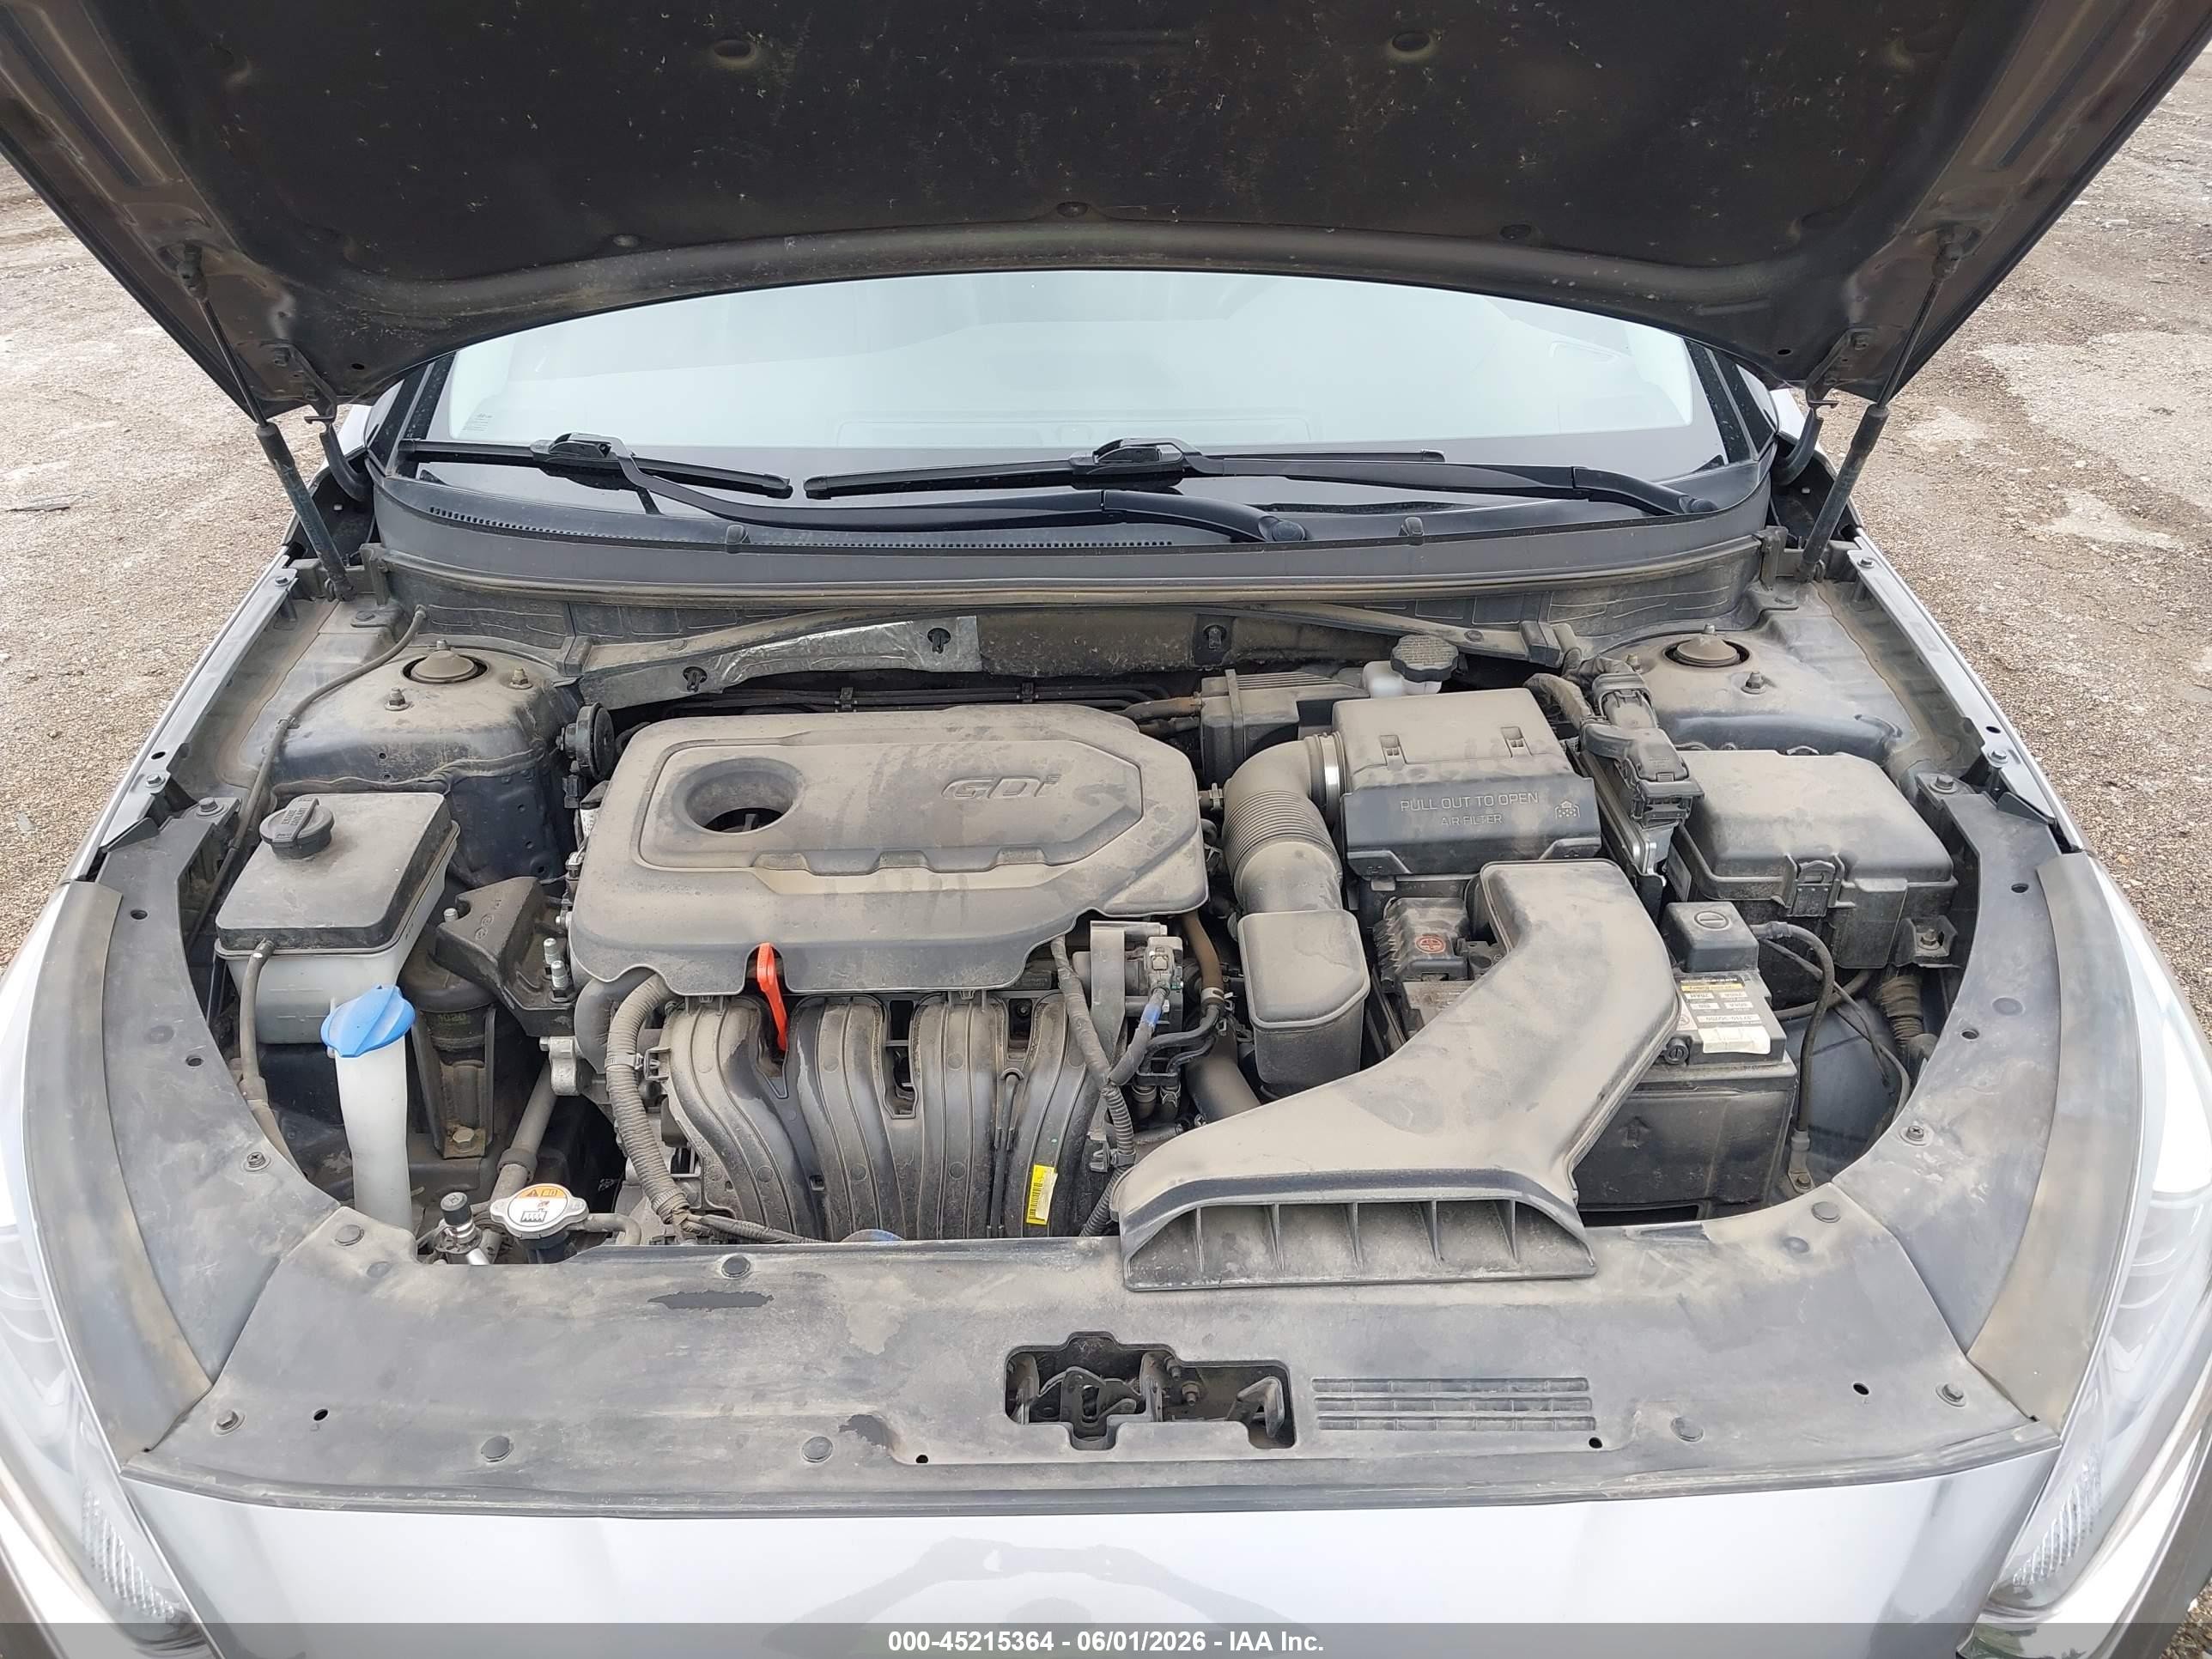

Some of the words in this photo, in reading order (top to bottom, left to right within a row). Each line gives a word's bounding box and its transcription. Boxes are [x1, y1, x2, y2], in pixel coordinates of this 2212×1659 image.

[1401, 799, 1437, 811] PULL
[1441, 796, 1471, 809] OUT
[1474, 795, 1494, 807] TO
[1498, 792, 1539, 805] OPEN
[1442, 817, 1460, 825] AIR
[1463, 814, 1503, 825] FILTER
